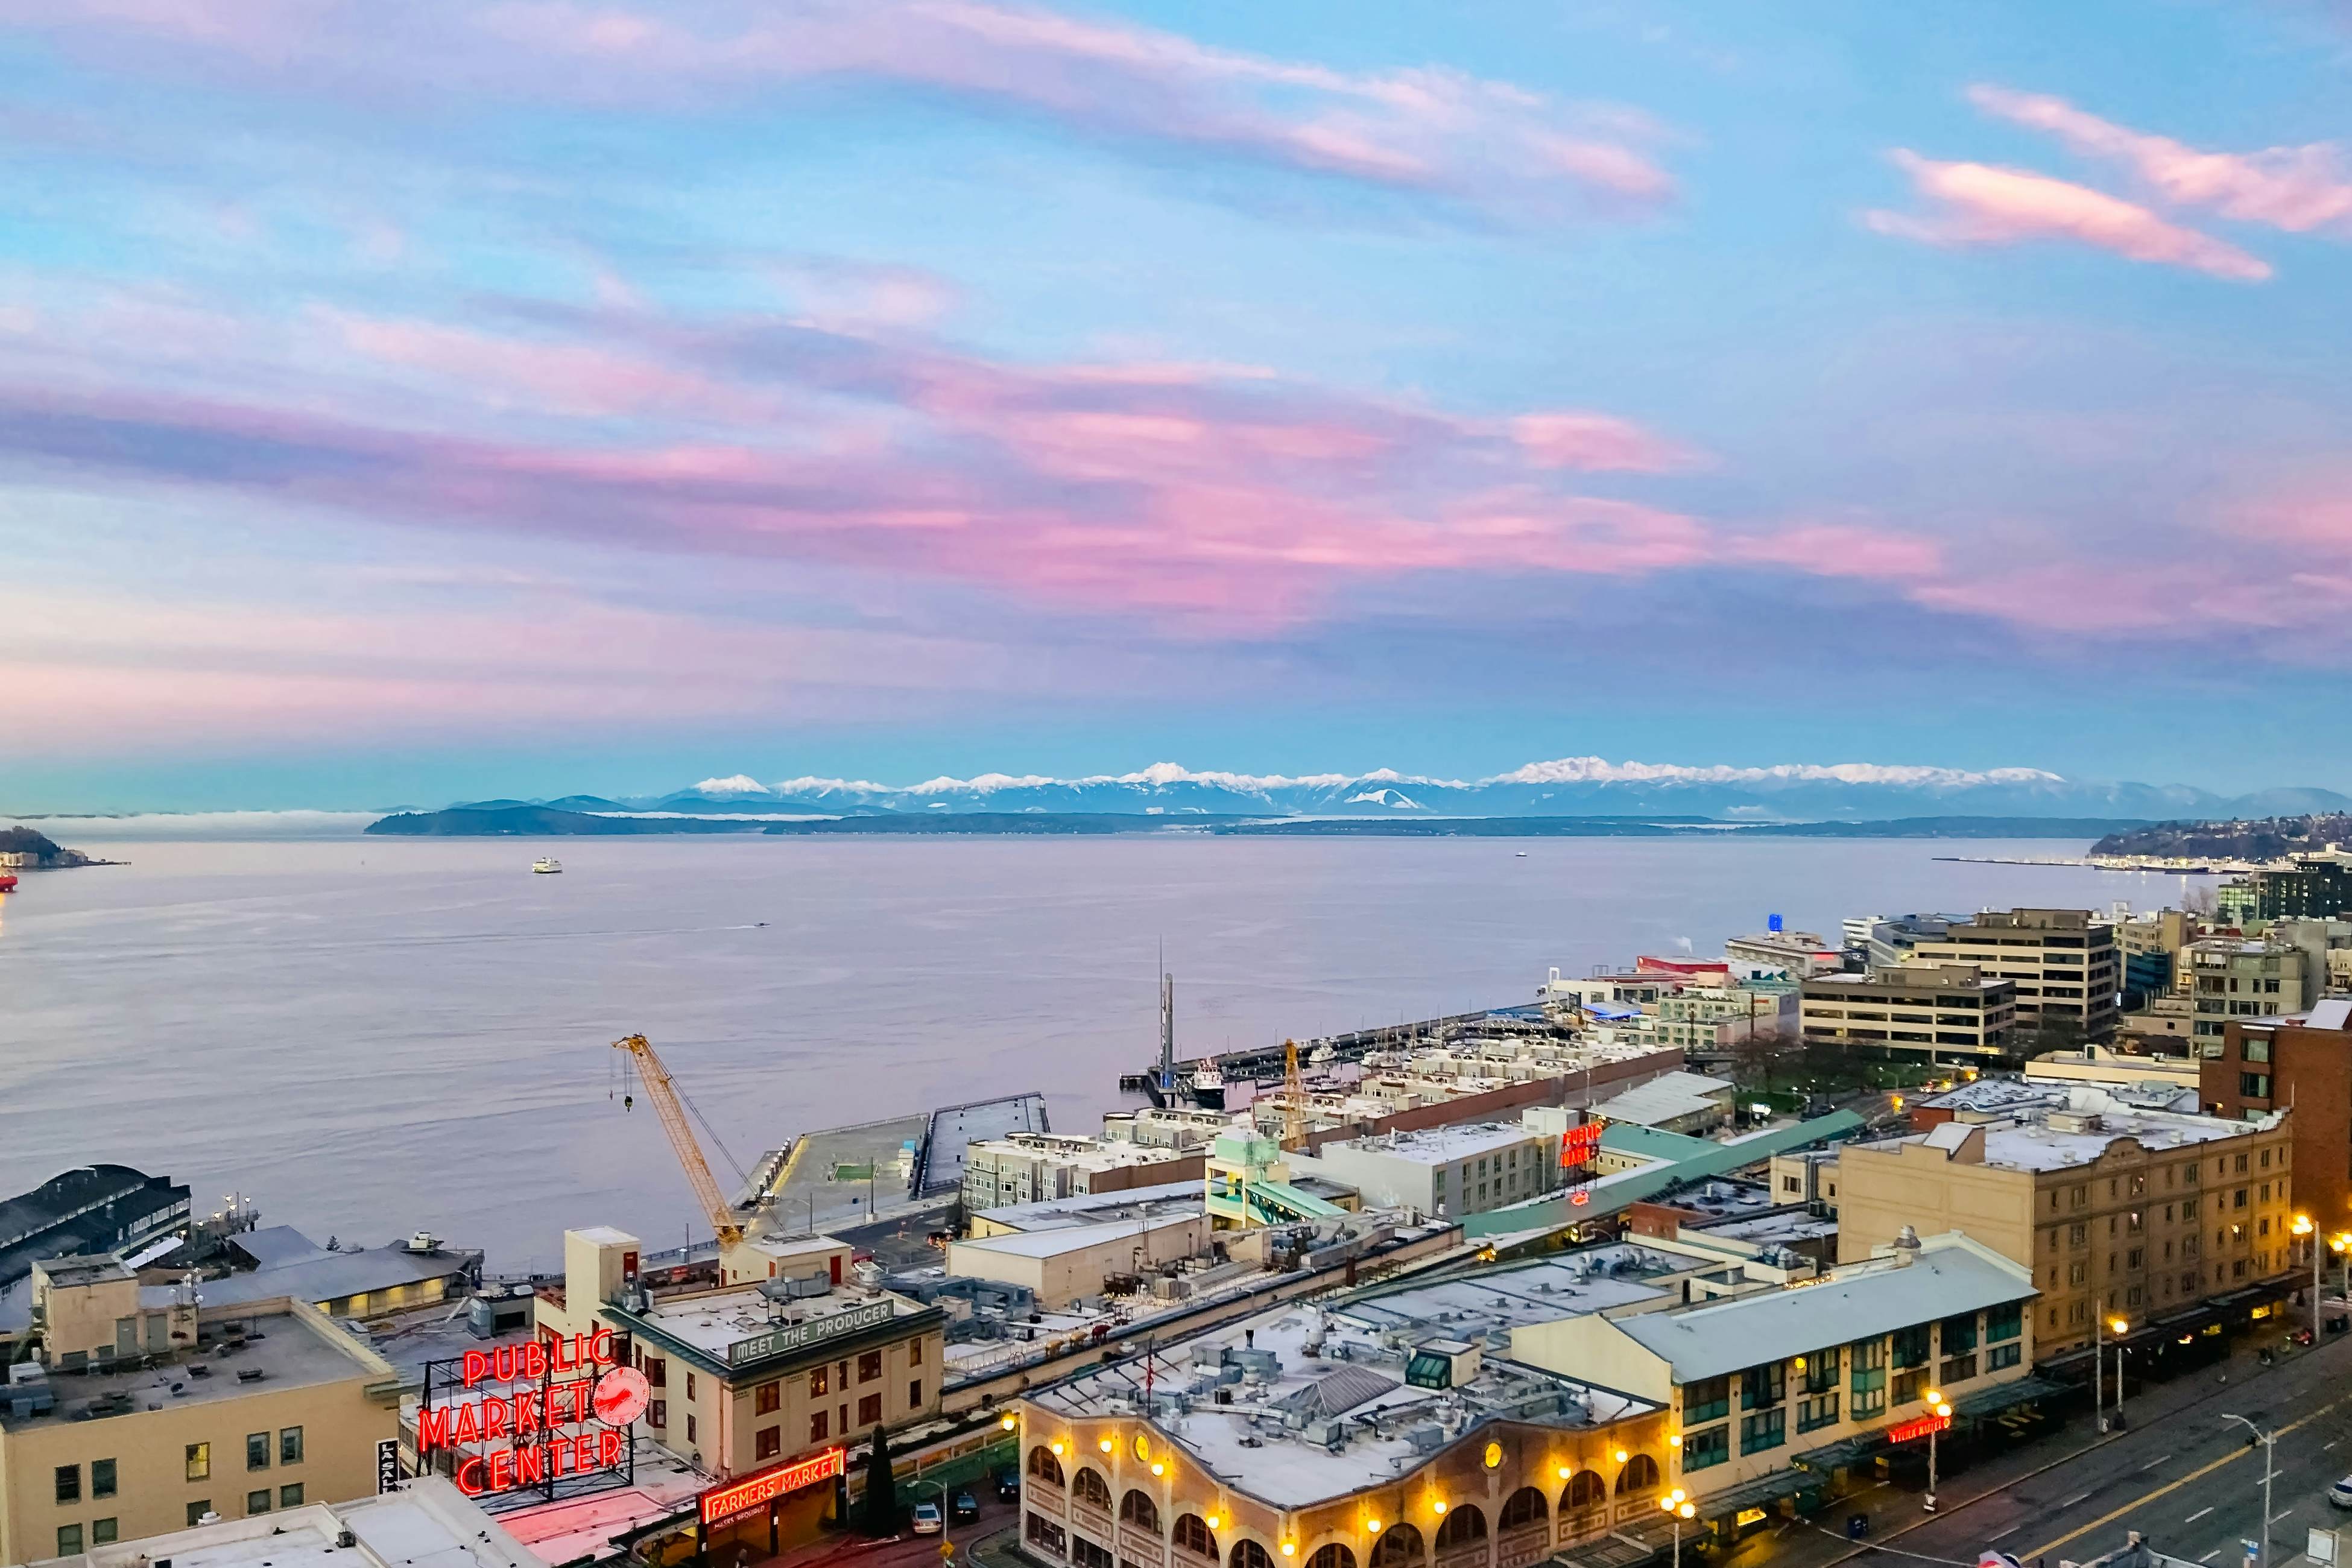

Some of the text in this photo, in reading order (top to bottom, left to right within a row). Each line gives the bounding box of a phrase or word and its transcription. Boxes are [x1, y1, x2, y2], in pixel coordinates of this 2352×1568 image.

[463, 1329, 614, 1389] PUBLIC
[738, 1304, 888, 1359] MEET THE PRODUCER
[419, 1381, 590, 1452] MARKET
[457, 1430, 622, 1496] CENTER
[712, 1457, 836, 1517] FARMERS MARKET
